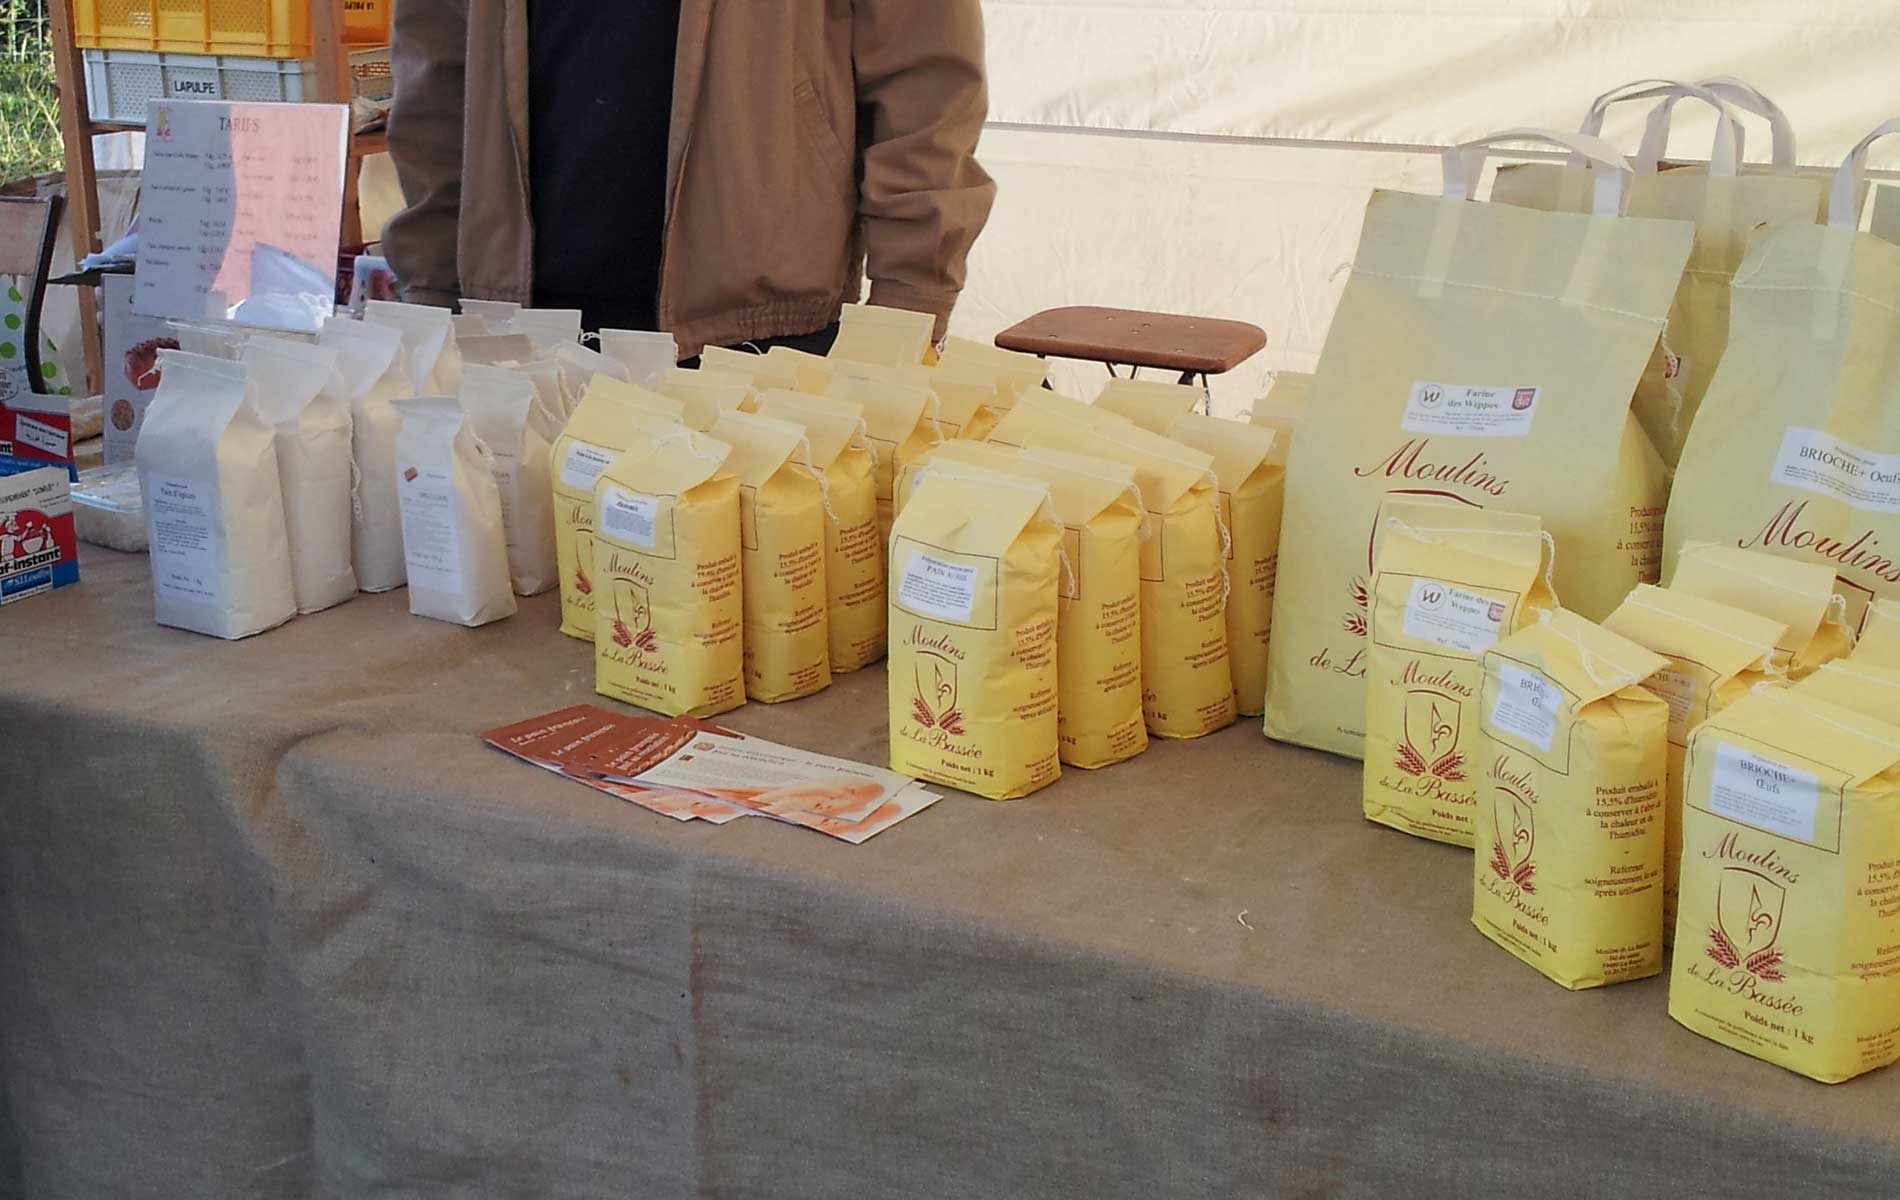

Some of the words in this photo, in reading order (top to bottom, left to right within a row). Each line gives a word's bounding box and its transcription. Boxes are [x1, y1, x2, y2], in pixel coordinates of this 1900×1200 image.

[174, 80, 215, 94] LAPULPE
[219, 116, 261, 132] TARIFS
[1354, 437, 1511, 496] Moulins
[1738, 500, 1900, 582] Moulins
[603, 553, 655, 586] Moulins
[903, 624, 966, 661] Moulins
[1390, 659, 1473, 698] Moulins
[909, 728, 928, 745] La
[928, 727, 983, 760] Bassée
[983, 768, 995, 778] kg
[1486, 754, 1541, 806] Moulins
[1390, 777, 1412, 794] La
[1596, 786, 1626, 796] Produit
[1596, 797, 1623, 807] 15,5%
[1431, 808, 1454, 820] Poids
[1585, 807, 1592, 817] à
[1593, 809, 1634, 818] conserver
[1600, 820, 1609, 829] la
[1610, 817, 1638, 829] chaleur
[1702, 831, 1801, 884] Moulins
[1610, 863, 1645, 875] Refermer
[1584, 872, 1642, 887] soigneusement
[1594, 888, 1617, 899] après
[1503, 881, 1549, 926] Bassée
[1687, 963, 1699, 977] de
[1700, 966, 1725, 988] La
[1727, 969, 1804, 1017] Bassée
[1744, 1010, 1769, 1028] Poids
[1770, 1022, 1785, 1034] net
[1801, 1032, 1814, 1045] kg
